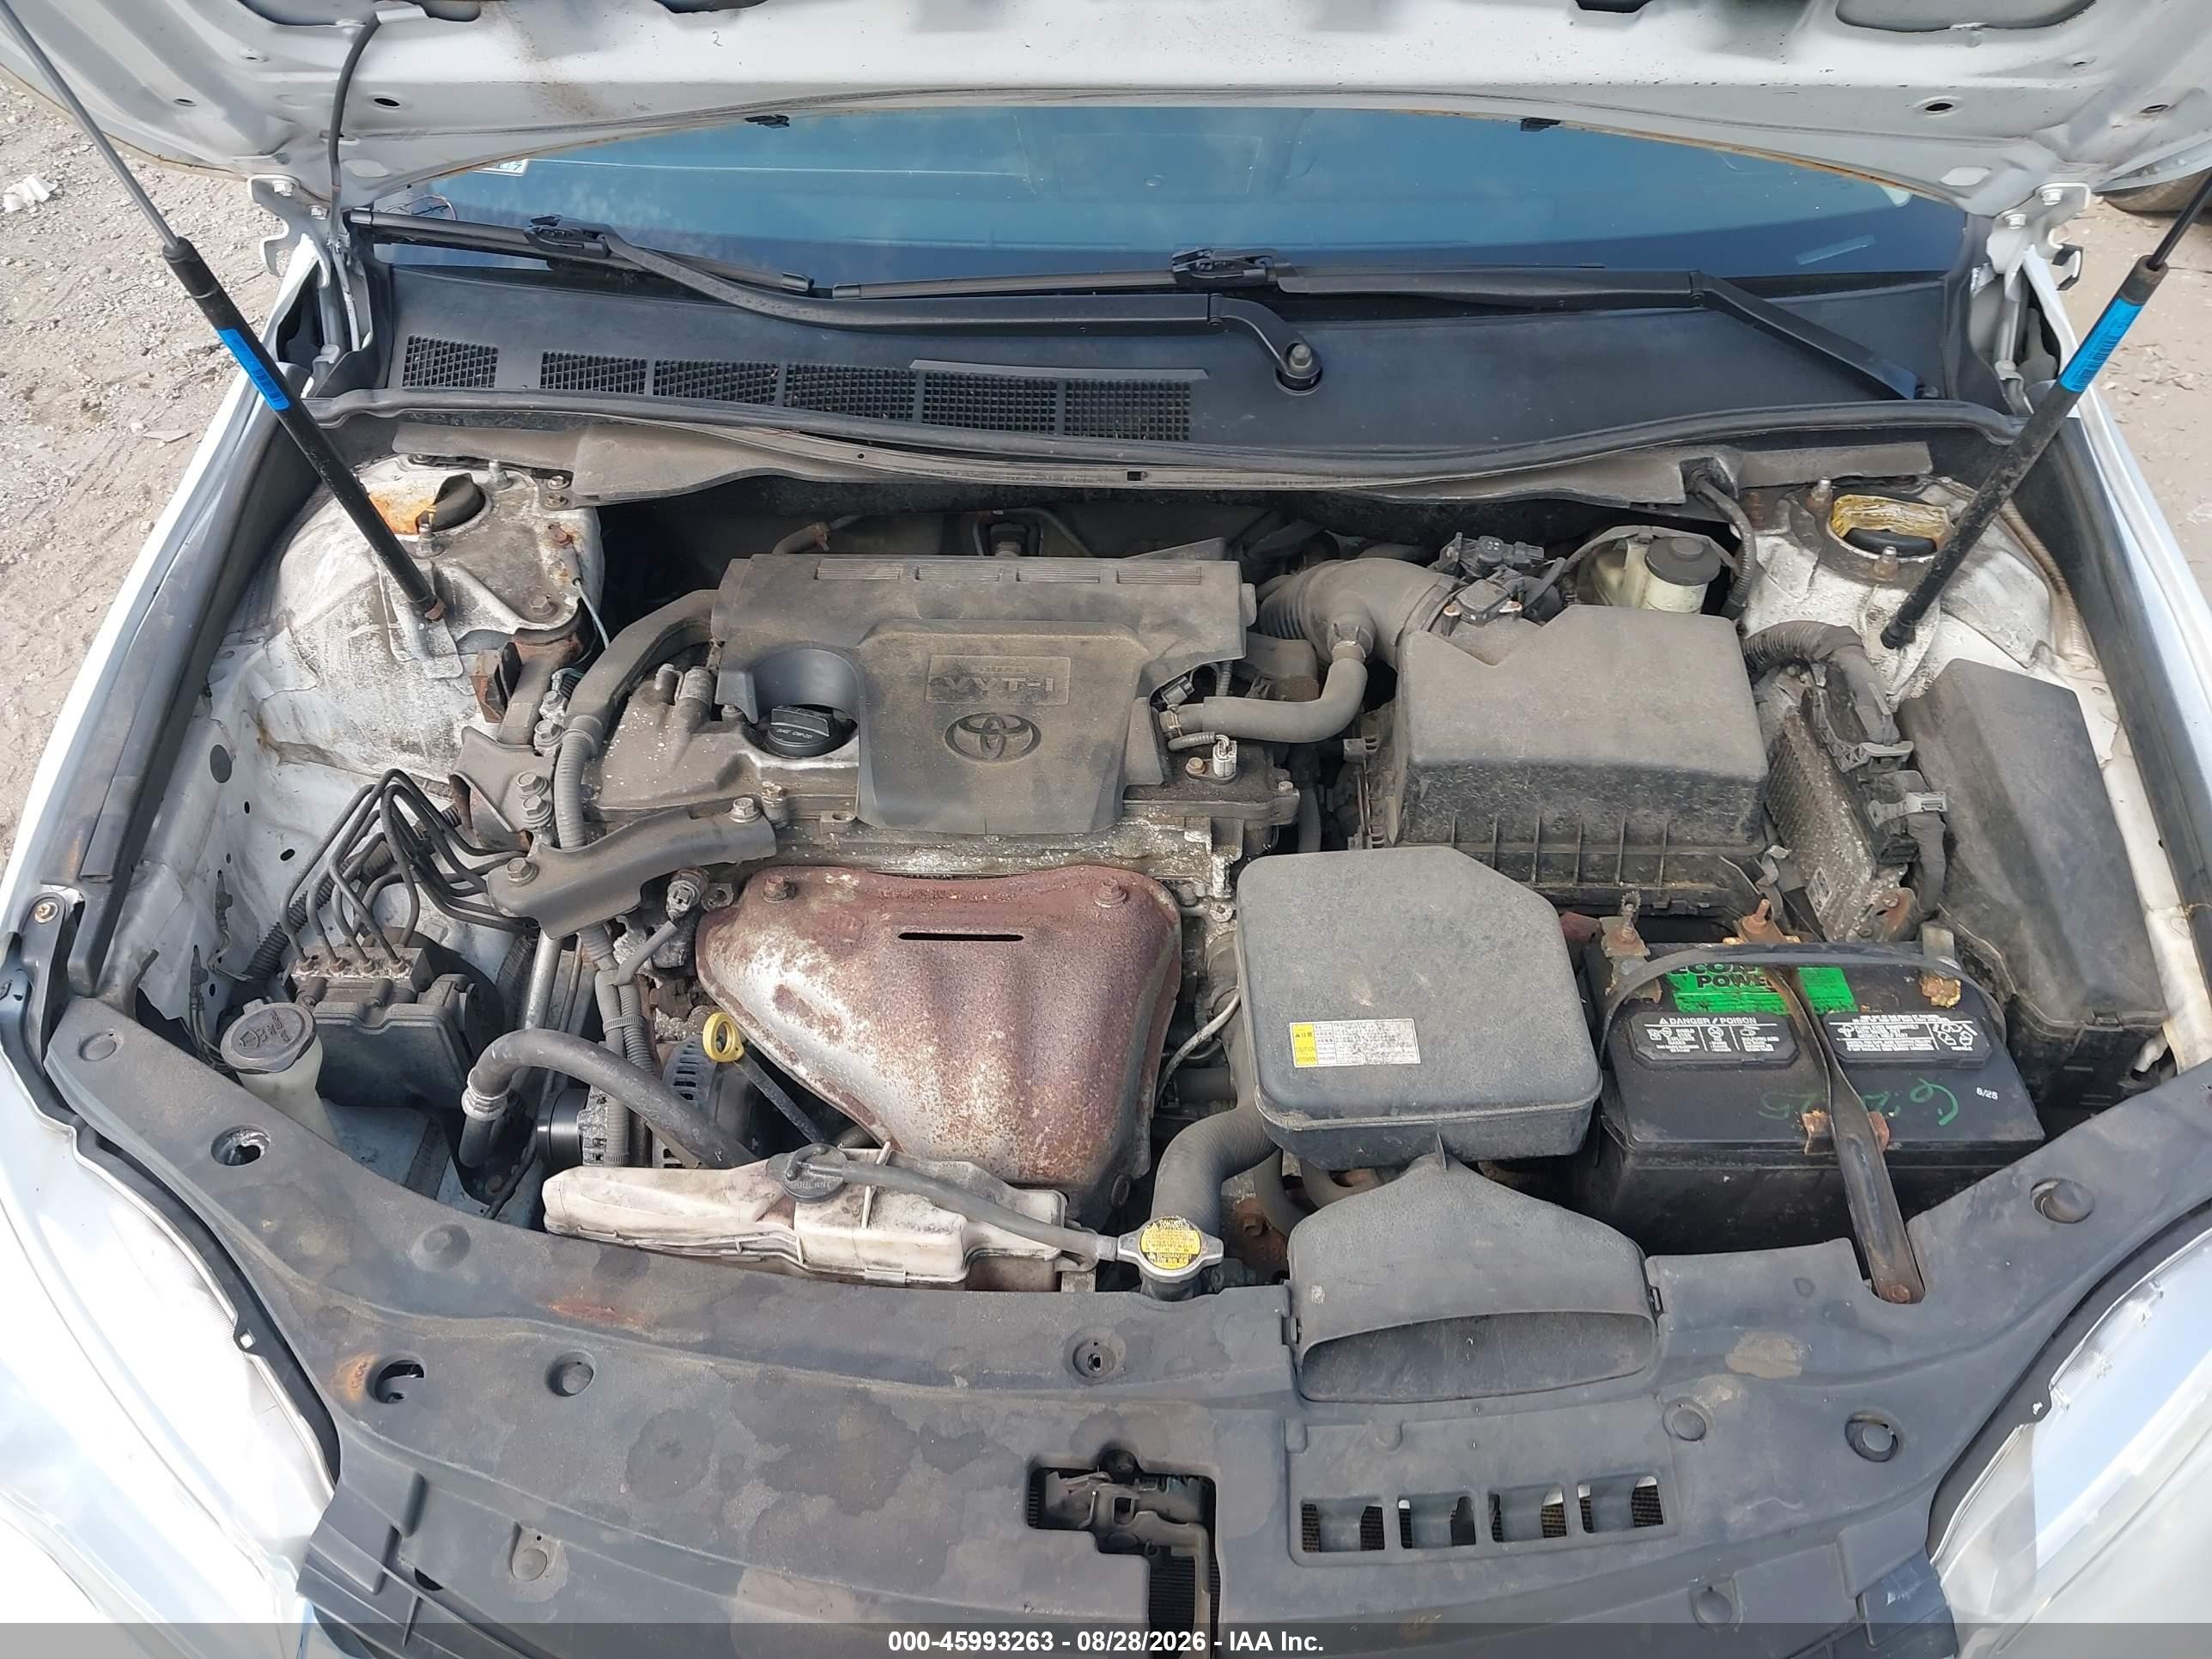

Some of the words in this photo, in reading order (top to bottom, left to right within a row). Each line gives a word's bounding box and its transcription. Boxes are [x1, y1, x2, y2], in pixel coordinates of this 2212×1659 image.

[1668, 1017, 1711, 1025] DANGER
[1718, 1017, 1758, 1025] POISON
[1976, 1085, 1999, 1101] 6/25
